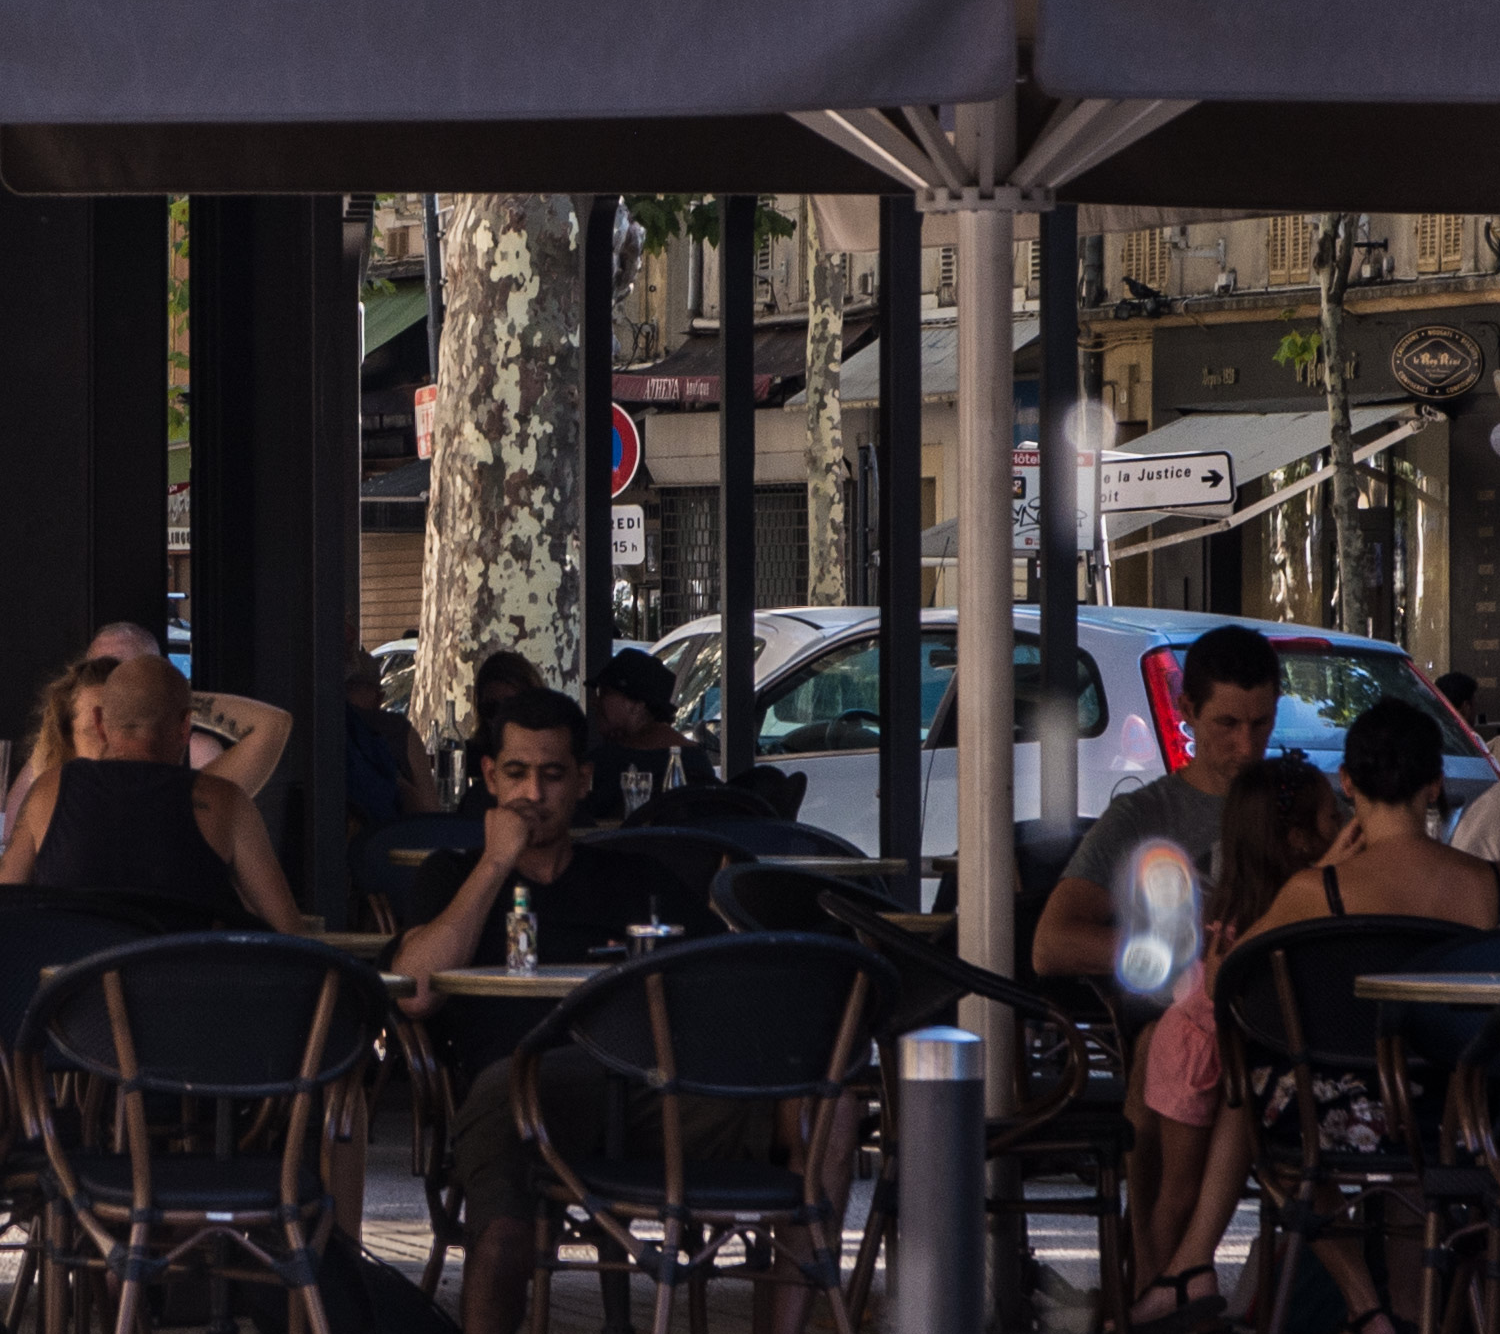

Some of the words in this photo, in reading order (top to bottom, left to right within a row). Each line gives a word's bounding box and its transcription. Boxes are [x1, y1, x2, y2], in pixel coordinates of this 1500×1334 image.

[643, 378, 680, 400] ATHENA
[1118, 470, 1130, 483] la
[1137, 465, 1192, 482] Justice
[613, 540, 628, 553] 15
[631, 543, 638, 553] h
